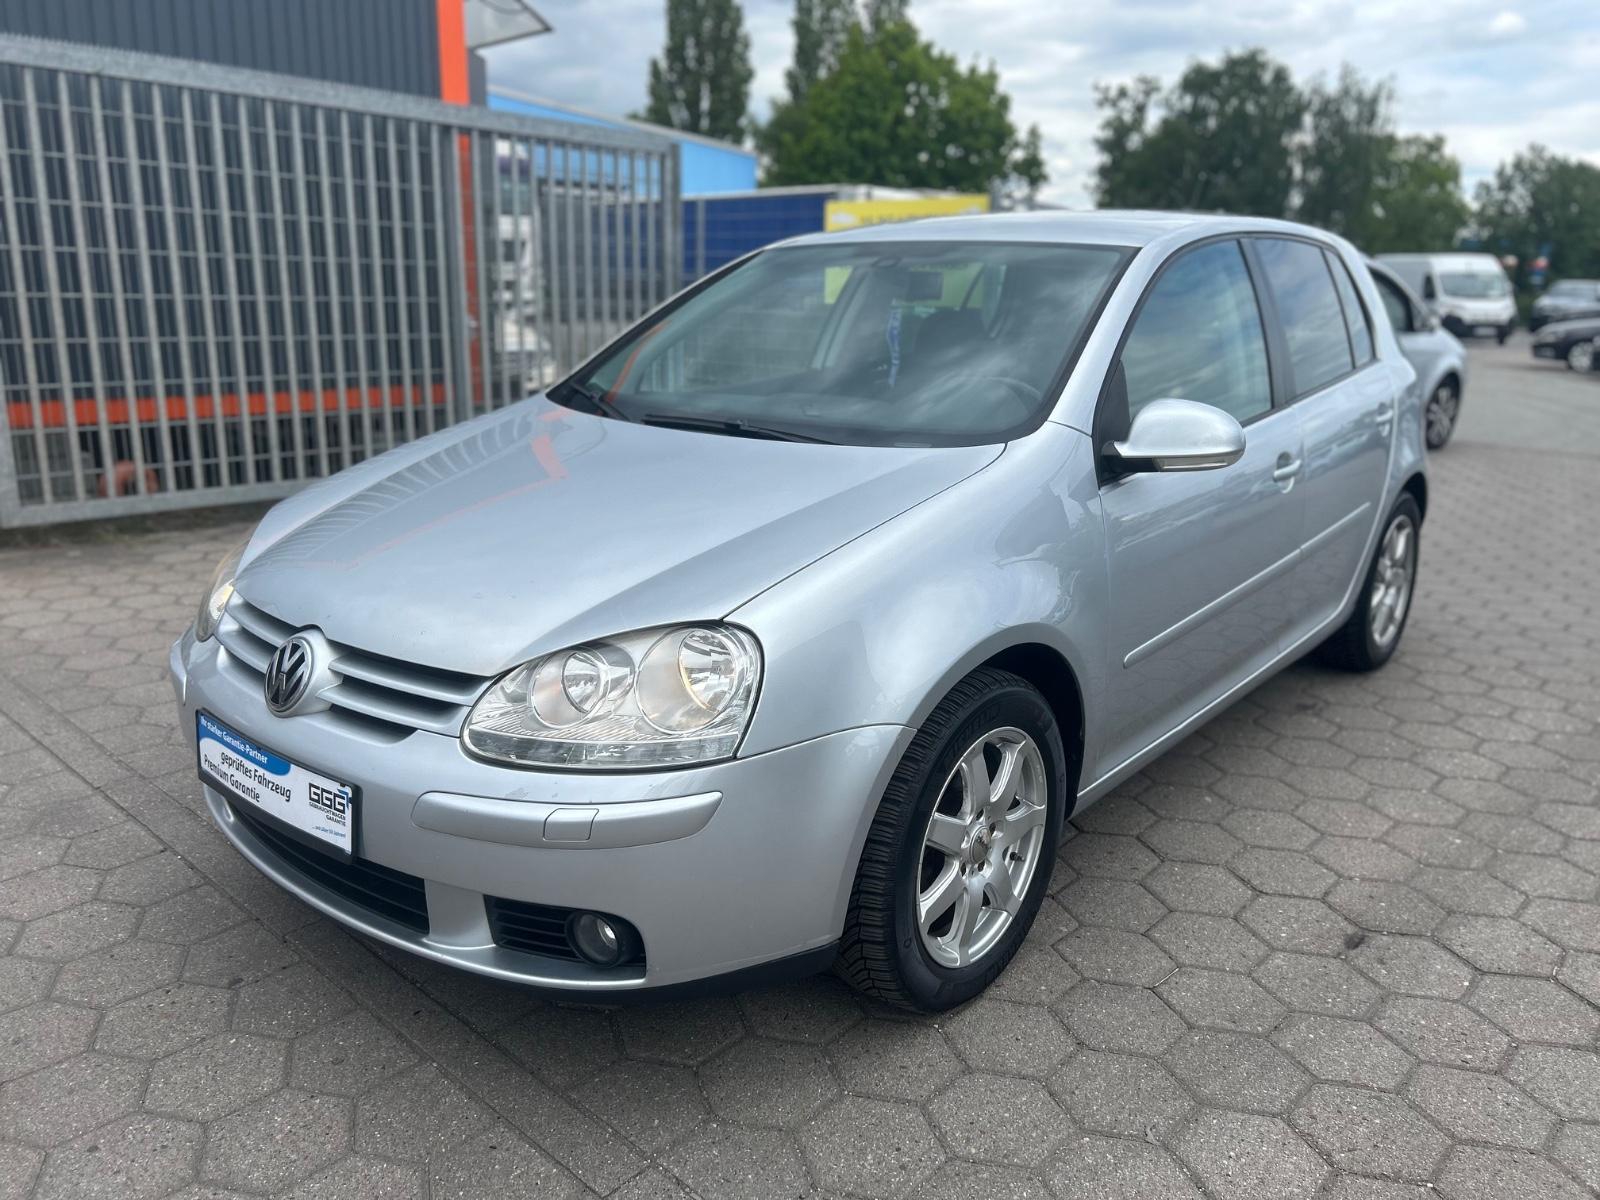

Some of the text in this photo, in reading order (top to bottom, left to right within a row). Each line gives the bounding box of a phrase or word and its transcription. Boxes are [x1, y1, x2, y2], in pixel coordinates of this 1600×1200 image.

[223, 731, 268, 763] Garantie-Partner
[204, 754, 260, 803] Premium Garantie
[221, 752, 291, 802] geprüftes Fahrzeug
[309, 782, 345, 815] GGG
